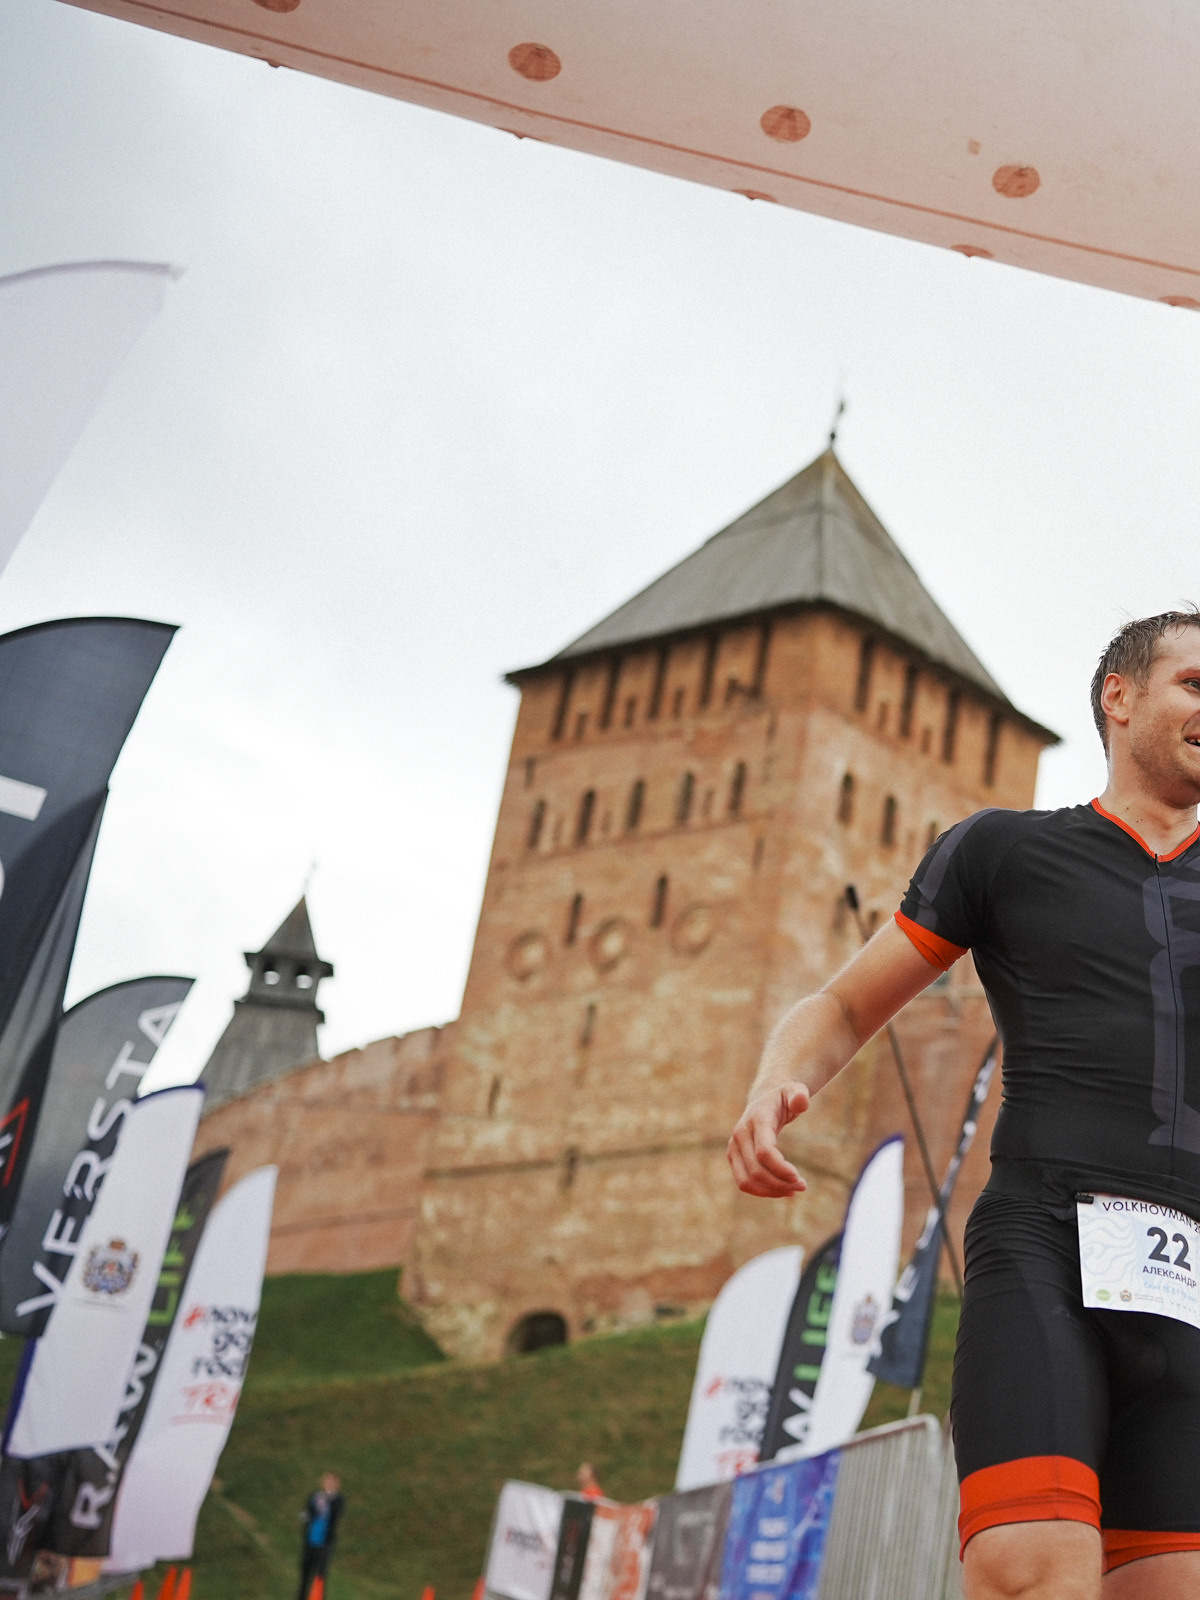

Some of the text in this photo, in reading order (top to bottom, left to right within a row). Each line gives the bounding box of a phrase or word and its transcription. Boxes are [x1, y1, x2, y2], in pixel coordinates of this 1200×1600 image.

[15, 1000, 184, 1318] VERSTA
[1102, 1200, 1192, 1229] VOLKHOVMAN
[1146, 1226, 1192, 1273] 22
[1142, 1265, 1197, 1288] АЛЕКСАНДР
